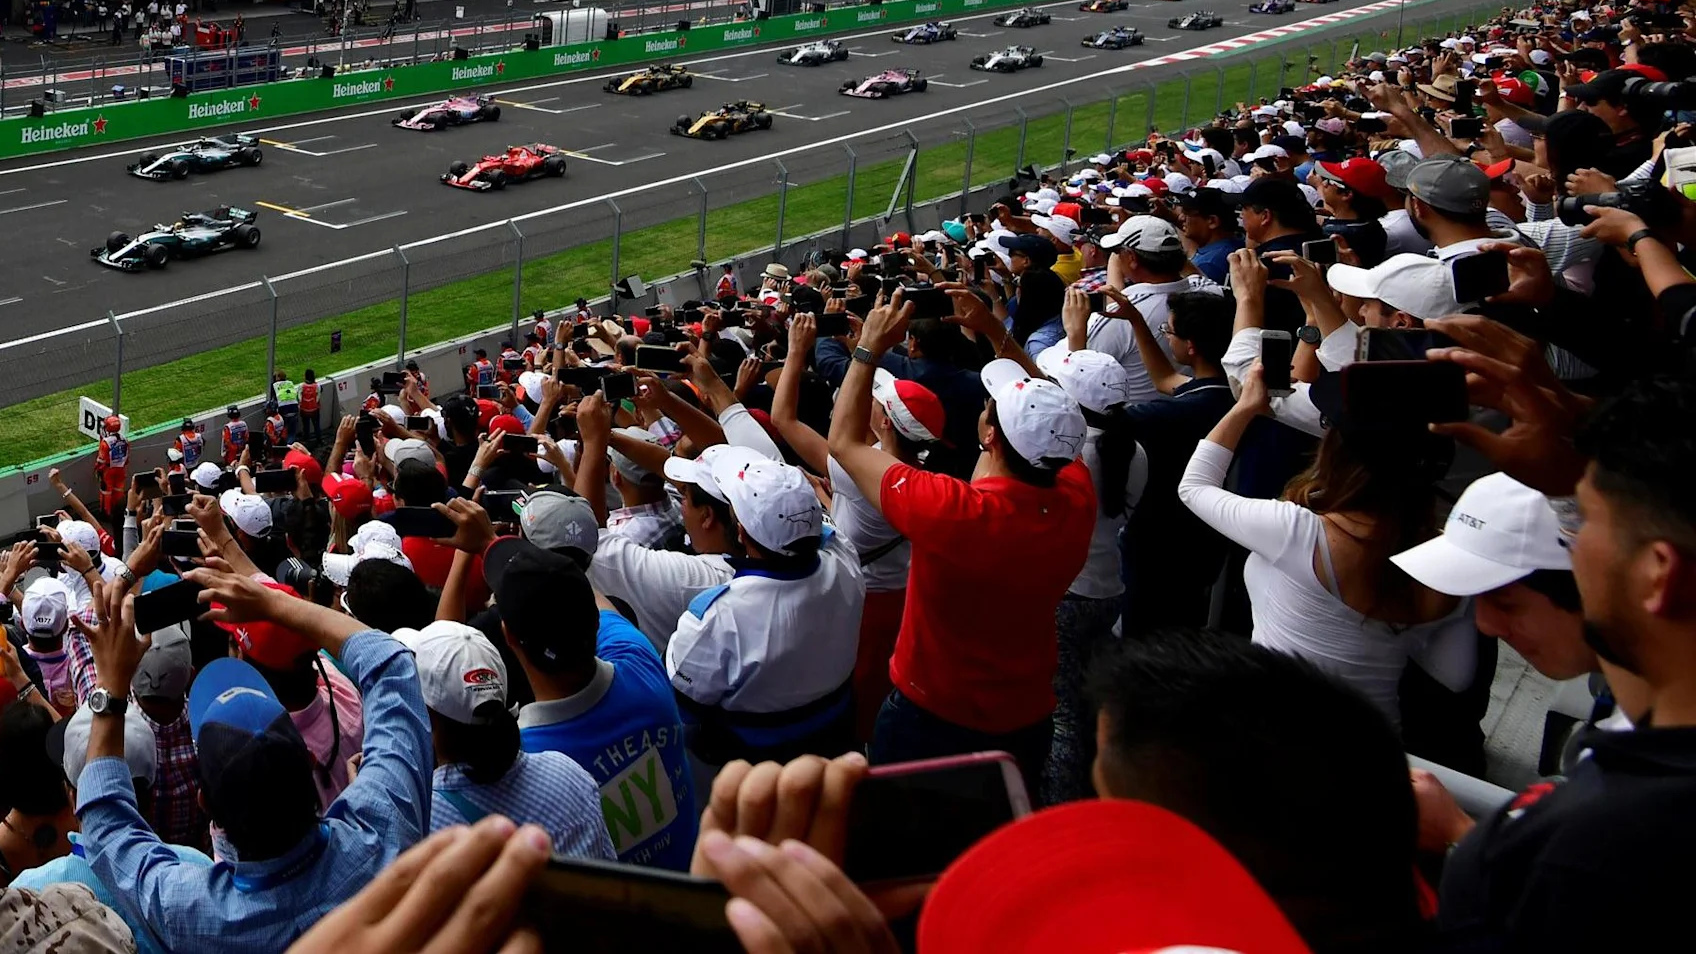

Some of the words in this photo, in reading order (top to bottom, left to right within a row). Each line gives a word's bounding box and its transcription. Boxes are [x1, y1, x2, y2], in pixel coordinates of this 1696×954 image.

[795, 17, 820, 28] Heineken
[724, 28, 752, 40] Heineken
[645, 39, 678, 52] Heineken
[554, 50, 590, 64] Heineken
[451, 63, 494, 79] Heineken
[333, 80, 381, 97] Heineken
[189, 100, 245, 118] Heineken
[21, 122, 89, 143] Heineken
[27, 473, 39, 485] 69
[1457, 513, 1486, 531] AT&T
[601, 757, 665, 849] NY
